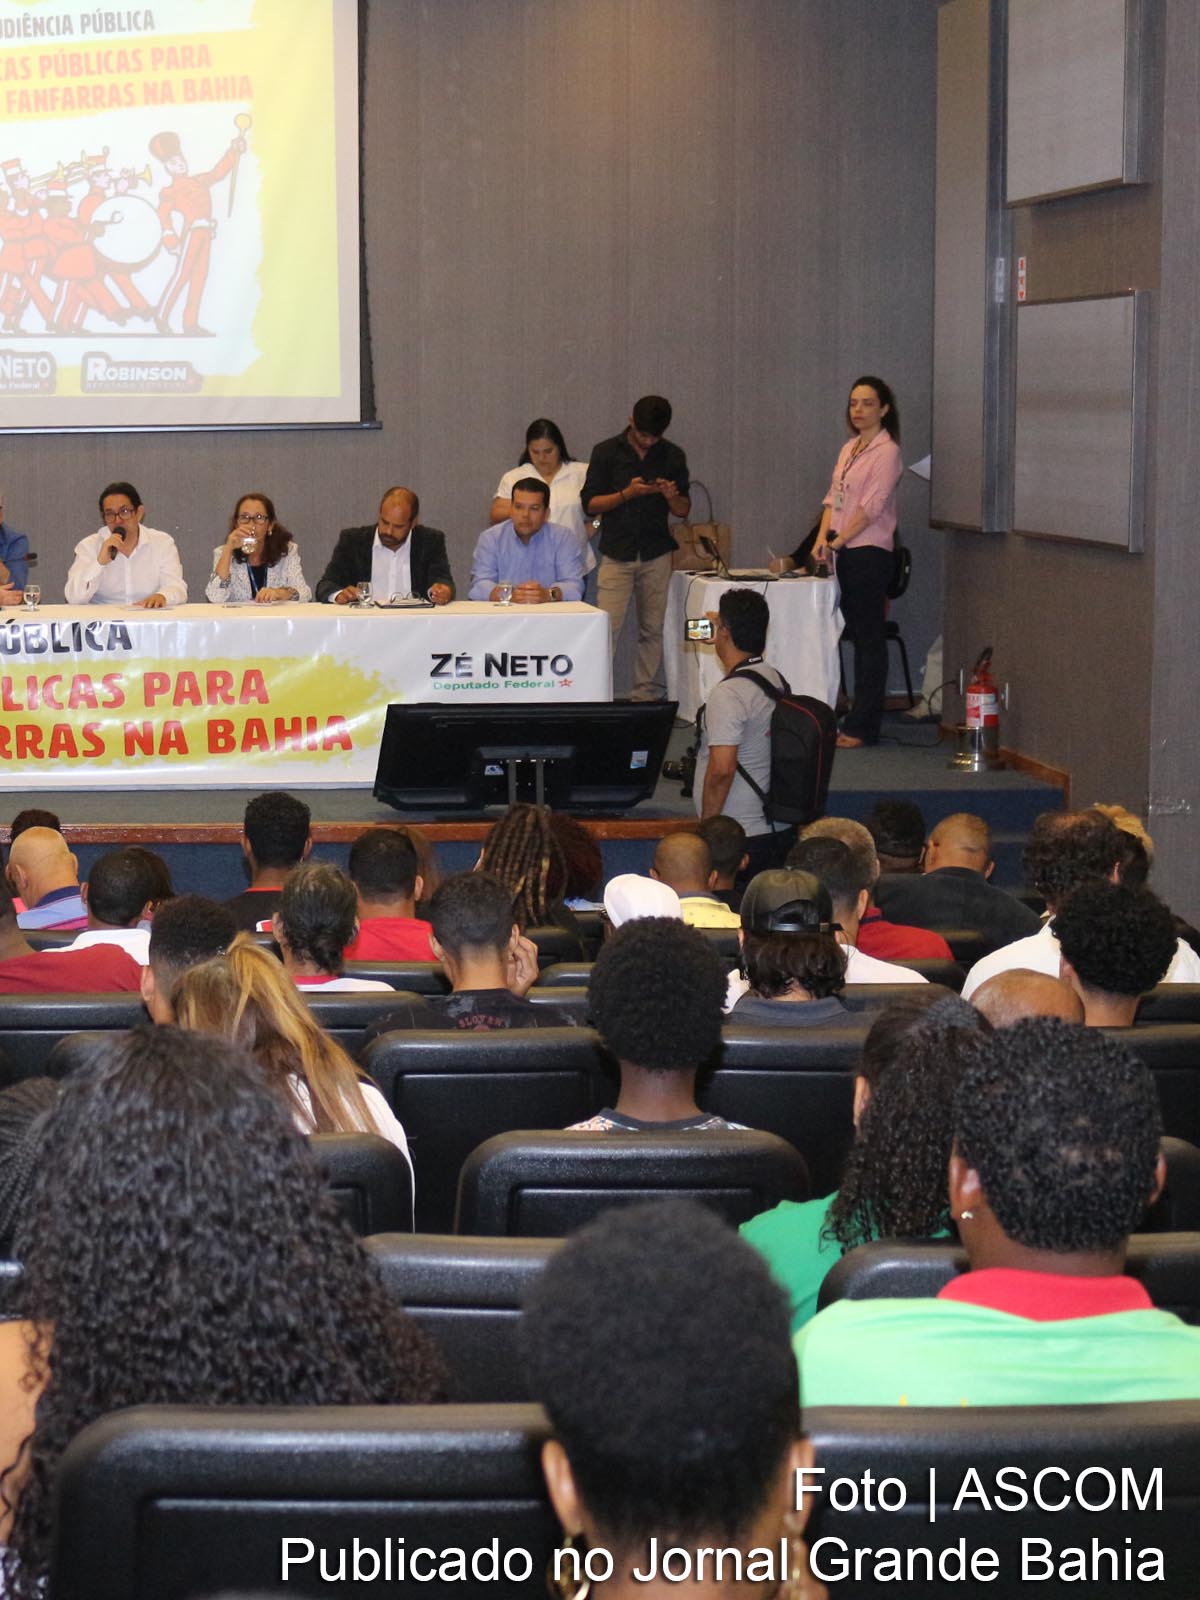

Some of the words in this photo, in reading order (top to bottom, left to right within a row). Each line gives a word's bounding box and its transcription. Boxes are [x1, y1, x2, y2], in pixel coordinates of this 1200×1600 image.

[80, 8, 155, 35] PÚBLICA
[39, 48, 144, 79] PÚBLICAS
[151, 44, 213, 72] PARA
[6, 82, 136, 115] FANFARRAS
[143, 80, 176, 106] NA
[182, 75, 254, 103] BAHIA
[86, 356, 188, 381] ROBINSON
[430, 652, 474, 678] ZÉ
[484, 652, 574, 678] NETO
[144, 668, 269, 707] PARA
[433, 680, 500, 691] Deputado
[503, 679, 555, 689] Federal
[124, 720, 188, 757] NA
[207, 715, 353, 754] BAHIA
